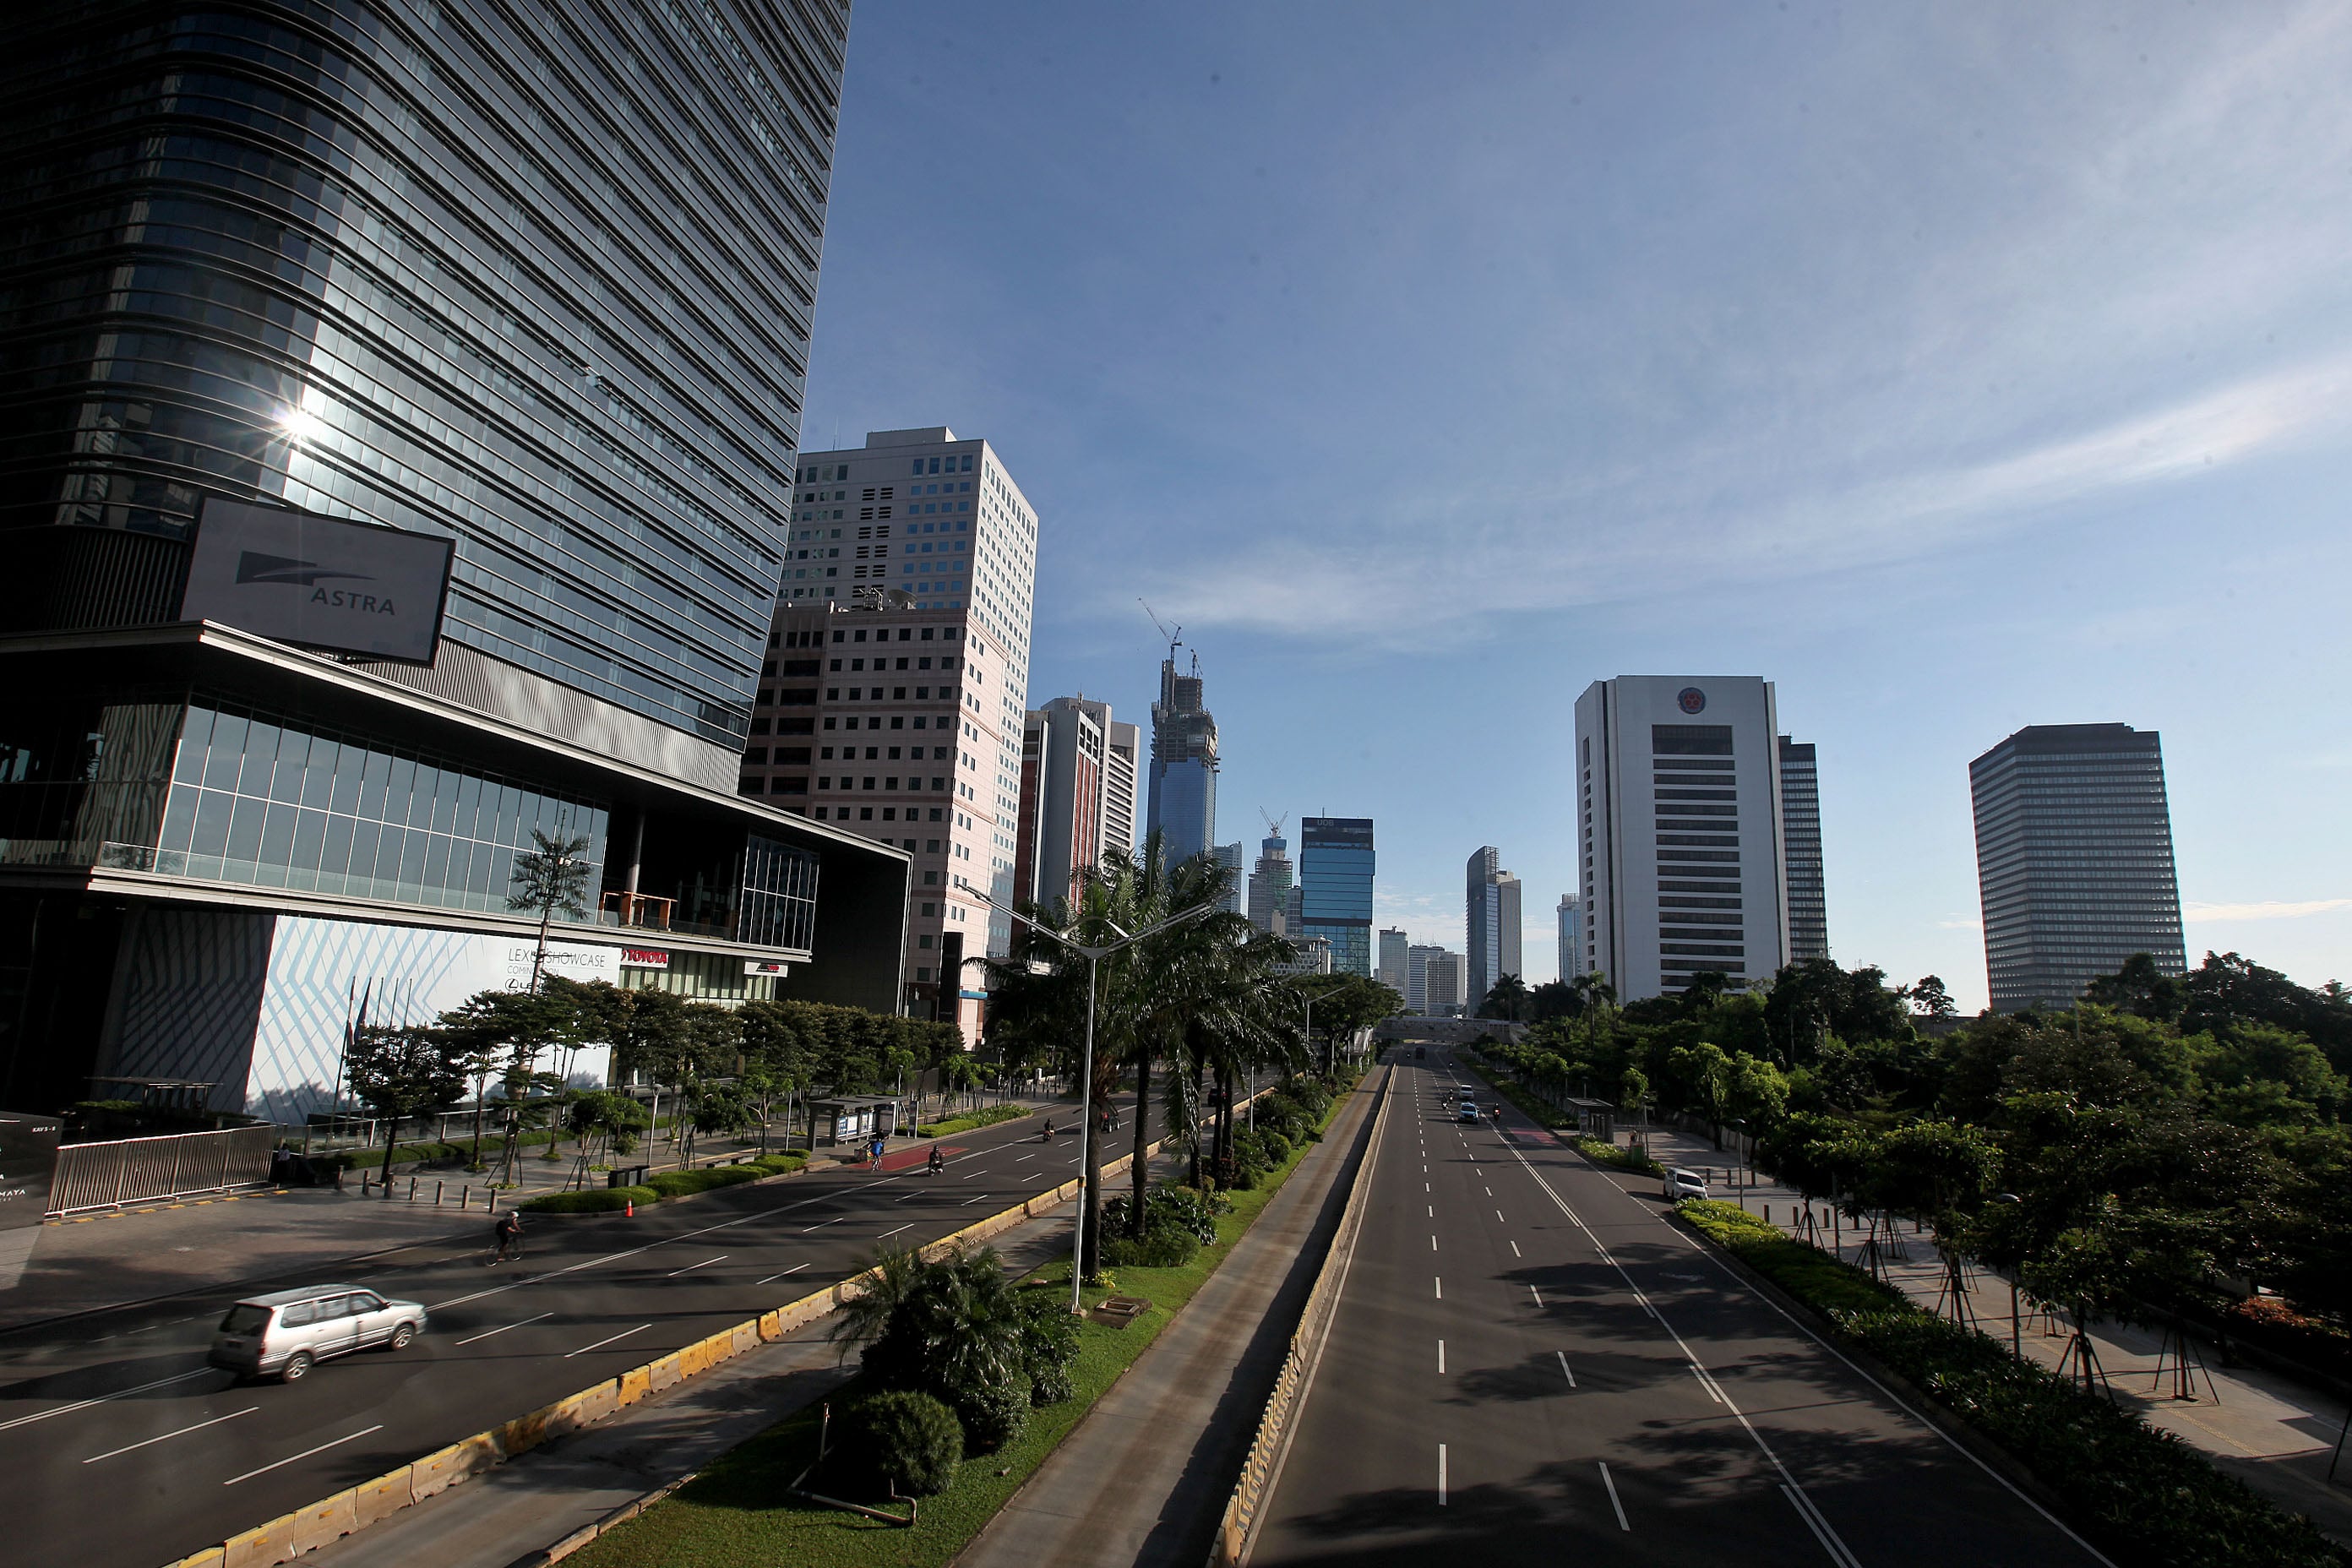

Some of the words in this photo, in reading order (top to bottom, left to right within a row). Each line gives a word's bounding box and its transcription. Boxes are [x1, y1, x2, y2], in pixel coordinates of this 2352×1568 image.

[311, 587, 395, 616] ASTRA
[509, 948, 545, 963] LEXU
[546, 950, 606, 967] SHOWCASE
[629, 949, 667, 964] TOYOTA
[507, 965, 538, 975] COMIN
